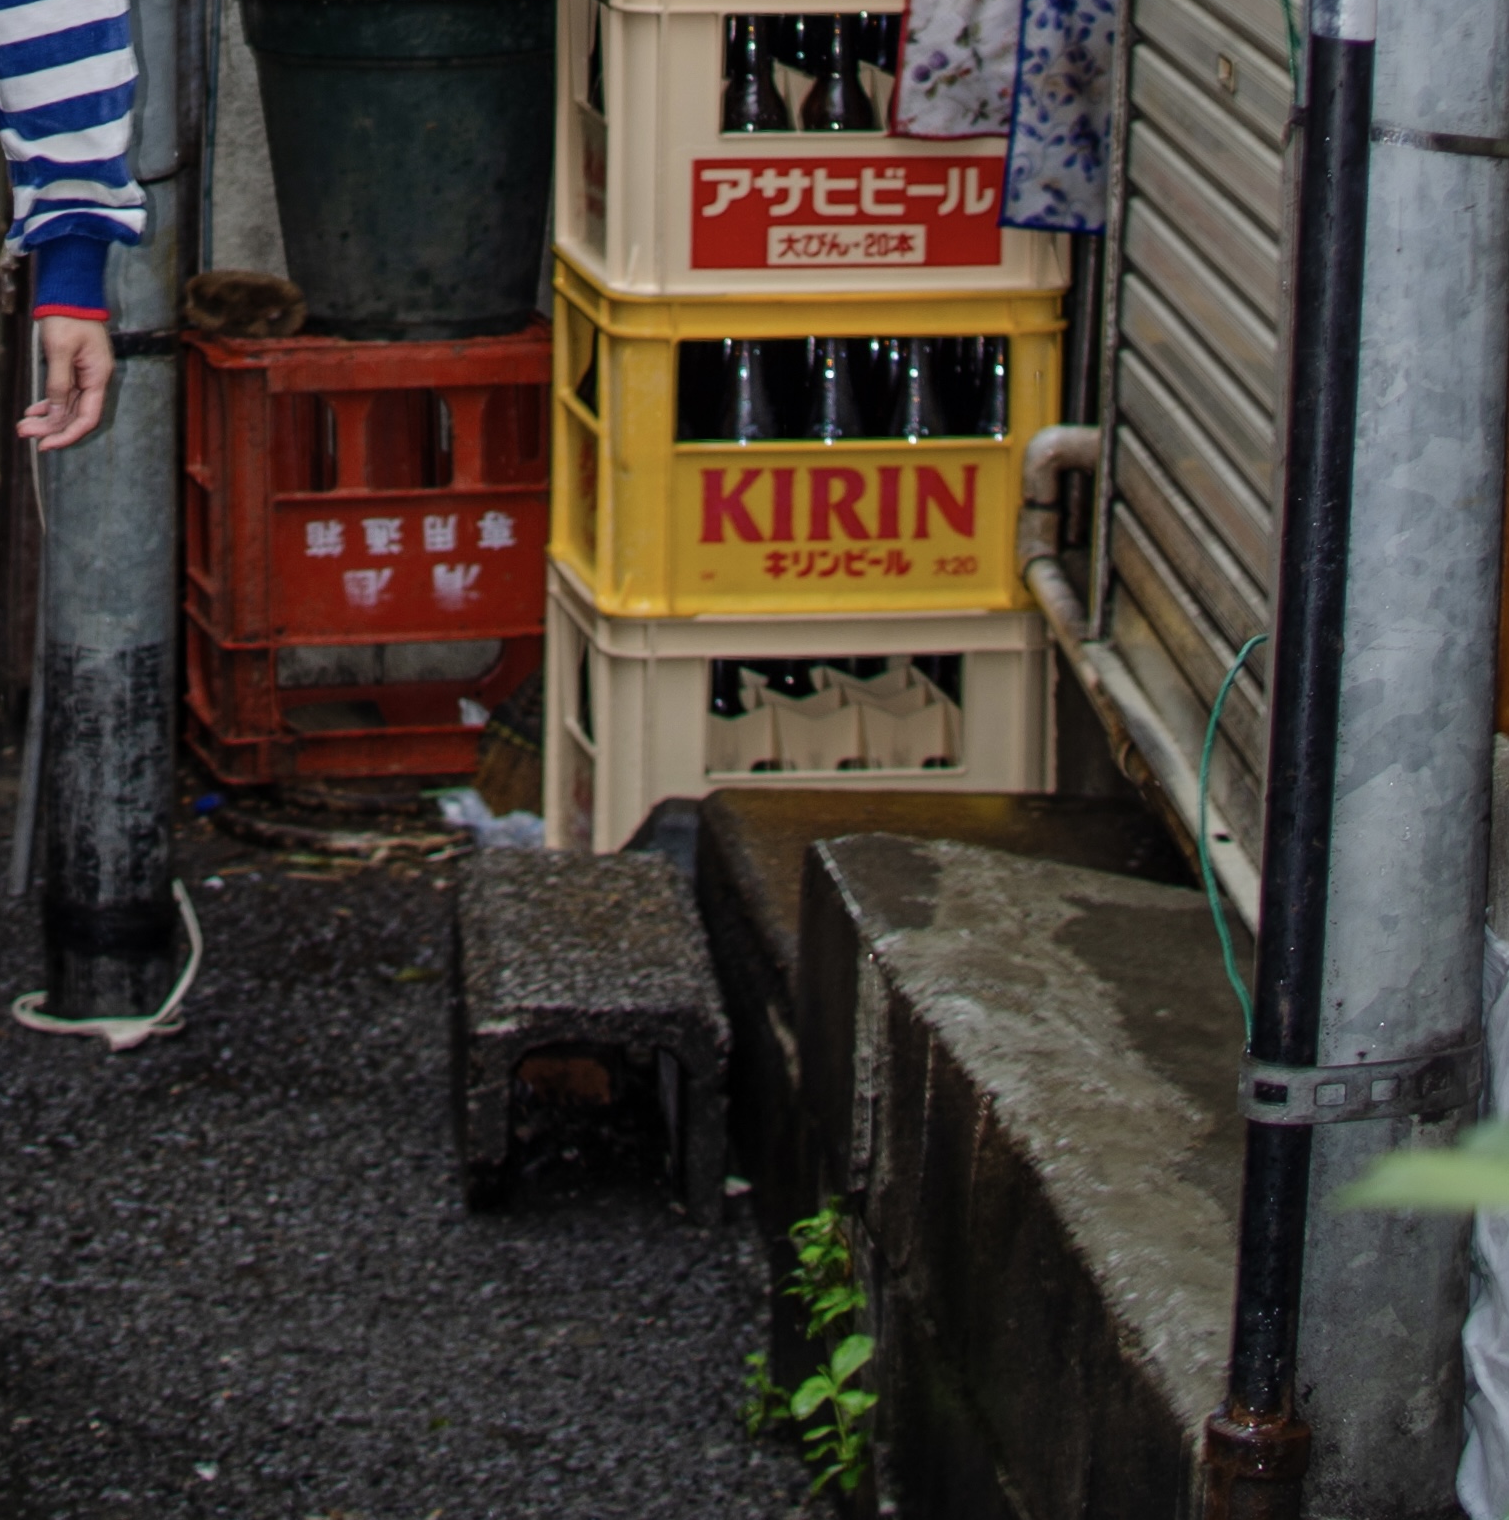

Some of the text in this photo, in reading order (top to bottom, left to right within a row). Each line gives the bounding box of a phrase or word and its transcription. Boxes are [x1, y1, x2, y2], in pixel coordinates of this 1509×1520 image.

[699, 166, 997, 218] アサヒビール
[698, 462, 979, 544] KIRIN
[762, 547, 912, 579] キリンビール
